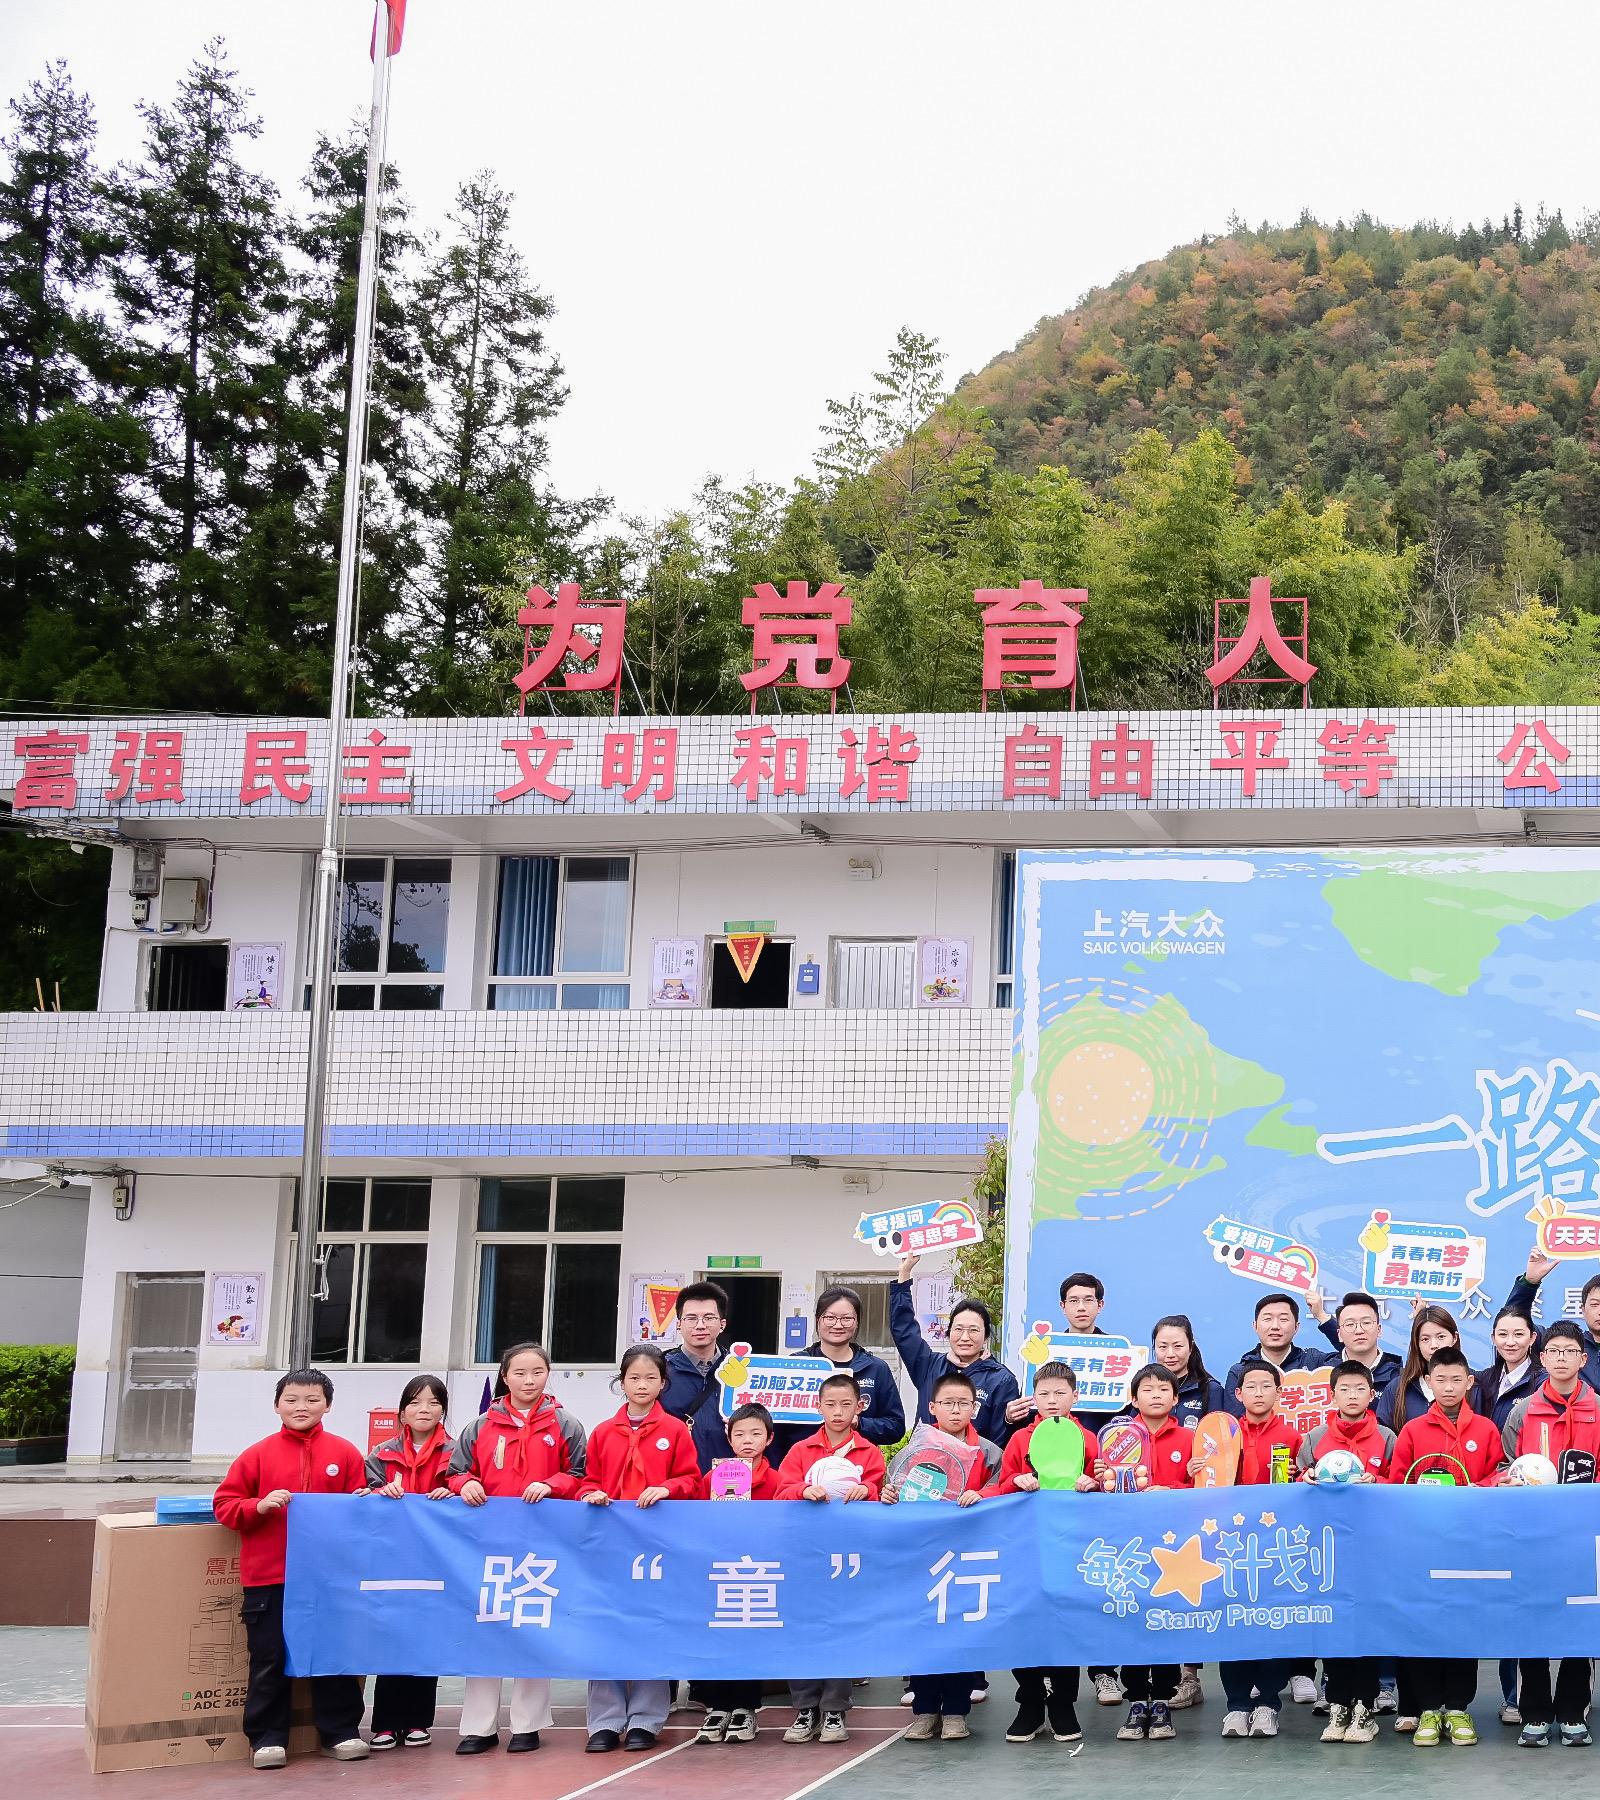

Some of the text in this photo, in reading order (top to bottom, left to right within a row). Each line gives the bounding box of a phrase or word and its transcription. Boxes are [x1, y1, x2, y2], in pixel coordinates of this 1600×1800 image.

[512, 576, 1318, 692] 为党育人
[12, 728, 186, 811] 富强
[240, 730, 412, 805] 民主
[495, 726, 678, 803] 文明
[730, 725, 920, 802] 和谐
[1002, 724, 1153, 800] 自由
[1209, 719, 1397, 797] 平等
[1083, 909, 1225, 938] 上汽大众
[1083, 941, 1226, 955] SAIC VOLKSWAGEN
[872, 1208, 924, 1233] 爱提问
[908, 1223, 958, 1247] 善思考
[1223, 1225, 1274, 1252] 爱提问
[1247, 1255, 1297, 1282] 善思考
[1391, 1245, 1470, 1268] 青春有梦
[1382, 1262, 1462, 1286] 勇敢前行
[204, 1576, 241, 1586] AUROR
[360, 1550, 1000, 1630] 一路“童”行
[1146, 1604, 1333, 1632] Starry Program
[193, 1686, 248, 1700] ADC 225
[193, 1700, 221, 1710] ADC
